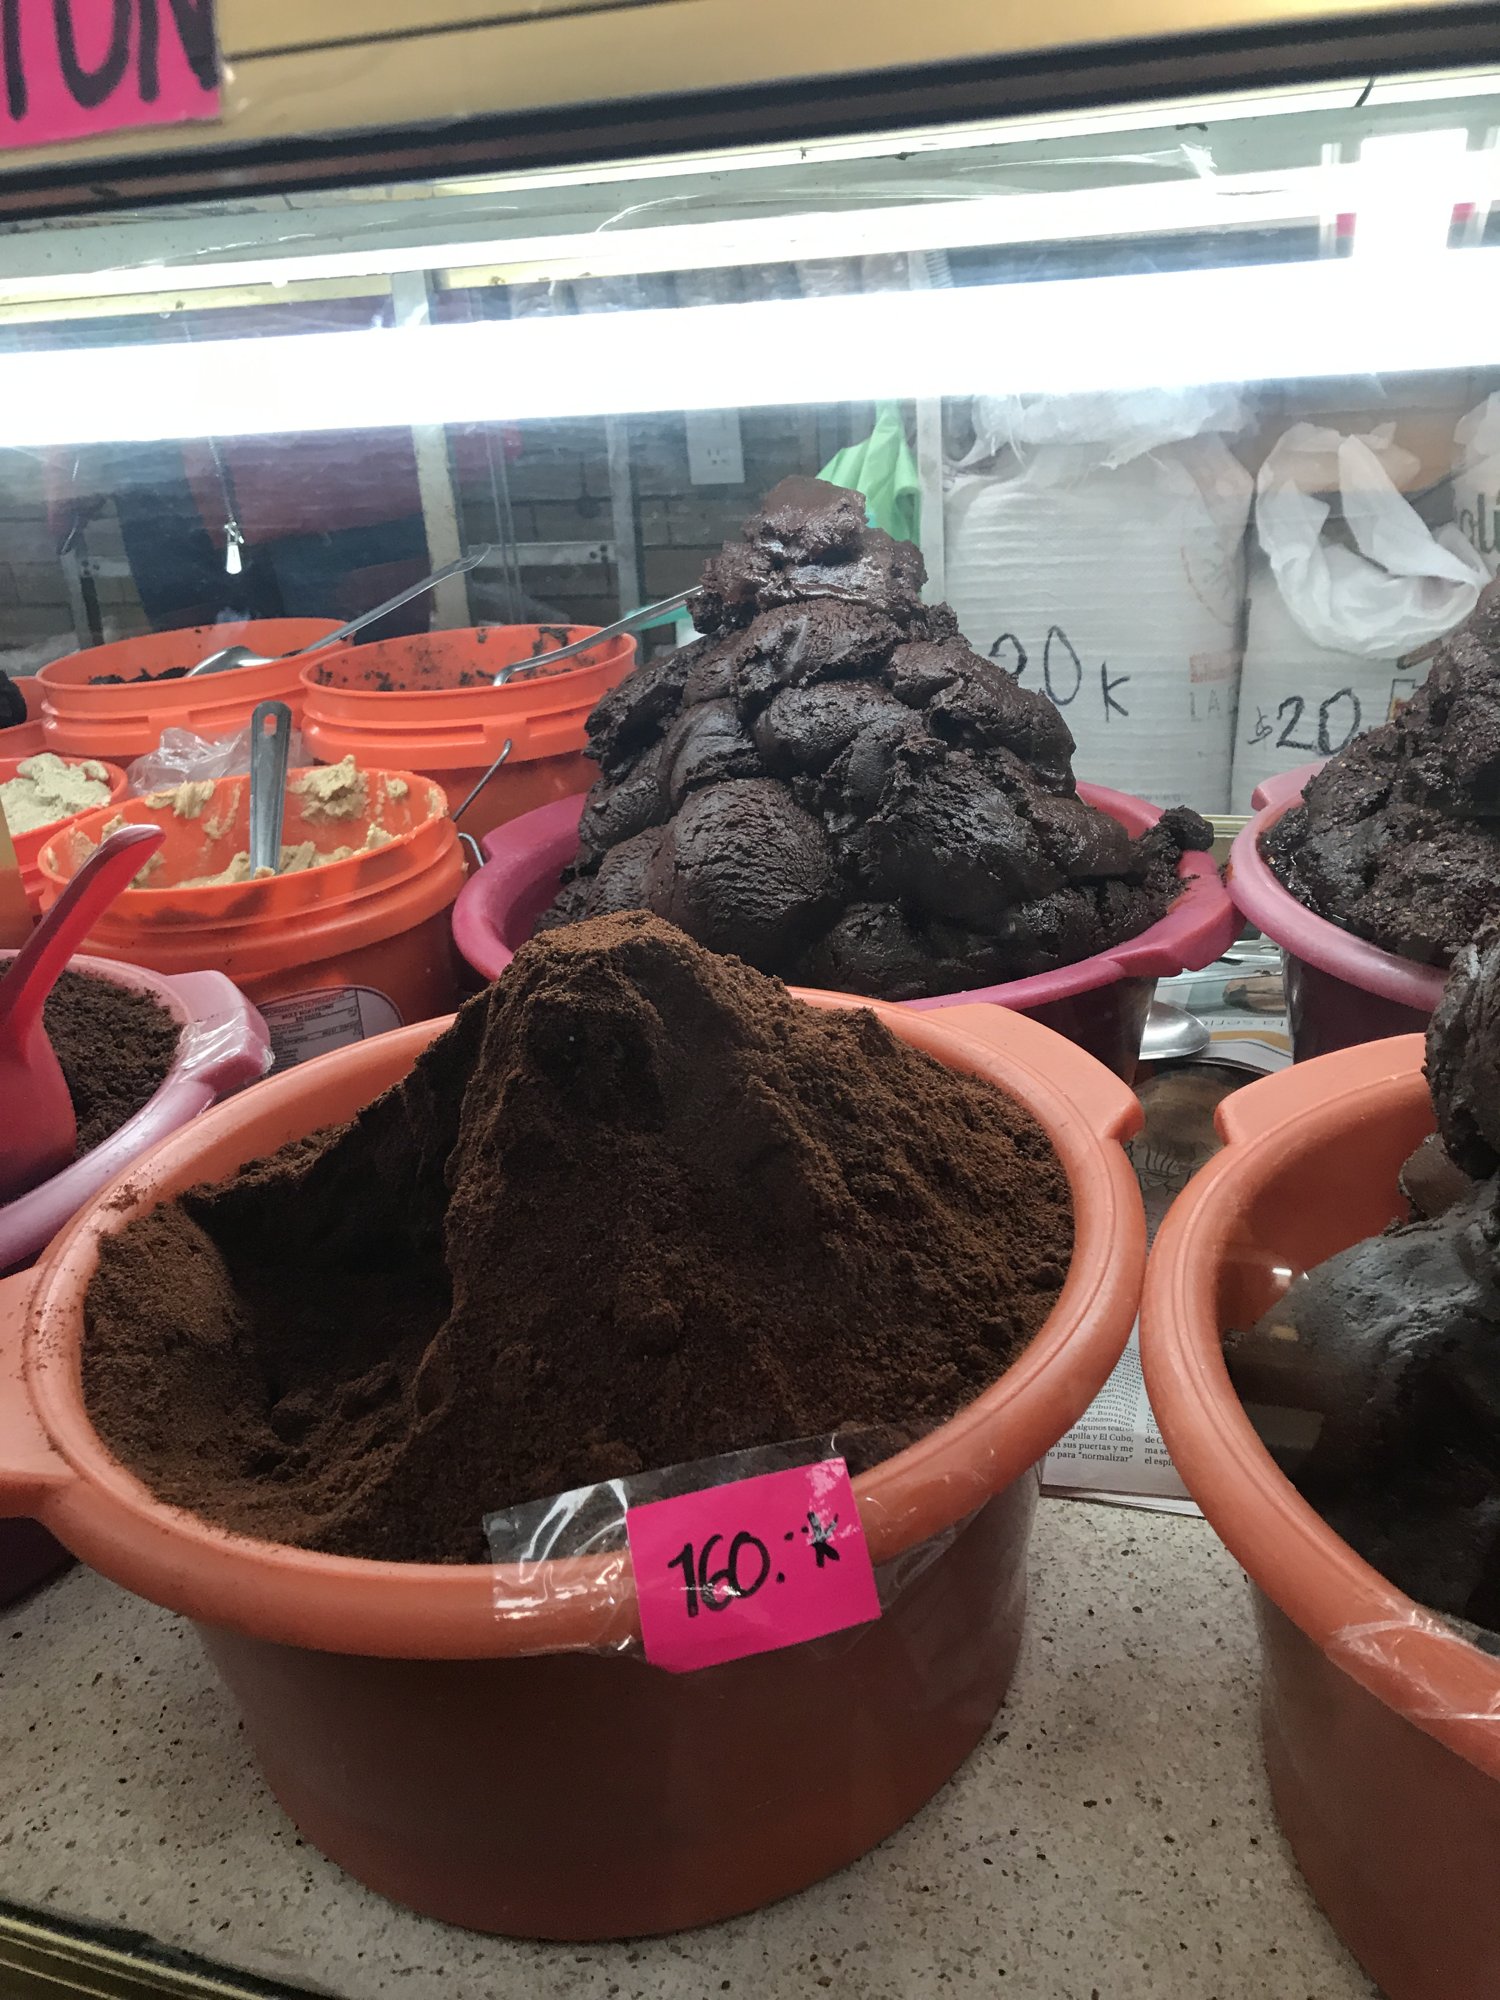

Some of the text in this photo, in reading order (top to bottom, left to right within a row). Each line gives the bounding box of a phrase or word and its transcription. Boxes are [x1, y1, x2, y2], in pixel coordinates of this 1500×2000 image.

[1076, 1423, 1107, 1432] algunos
[1099, 1433, 1108, 1441] El
[1109, 1433, 1134, 1443] Cubo,
[1144, 1435, 1155, 1443] de
[1079, 1442, 1111, 1451] puertas
[1113, 1444, 1118, 1453] y
[1120, 1445, 1134, 1453] me
[1057, 1450, 1077, 1459] para
[1144, 1456, 1152, 1464] el
